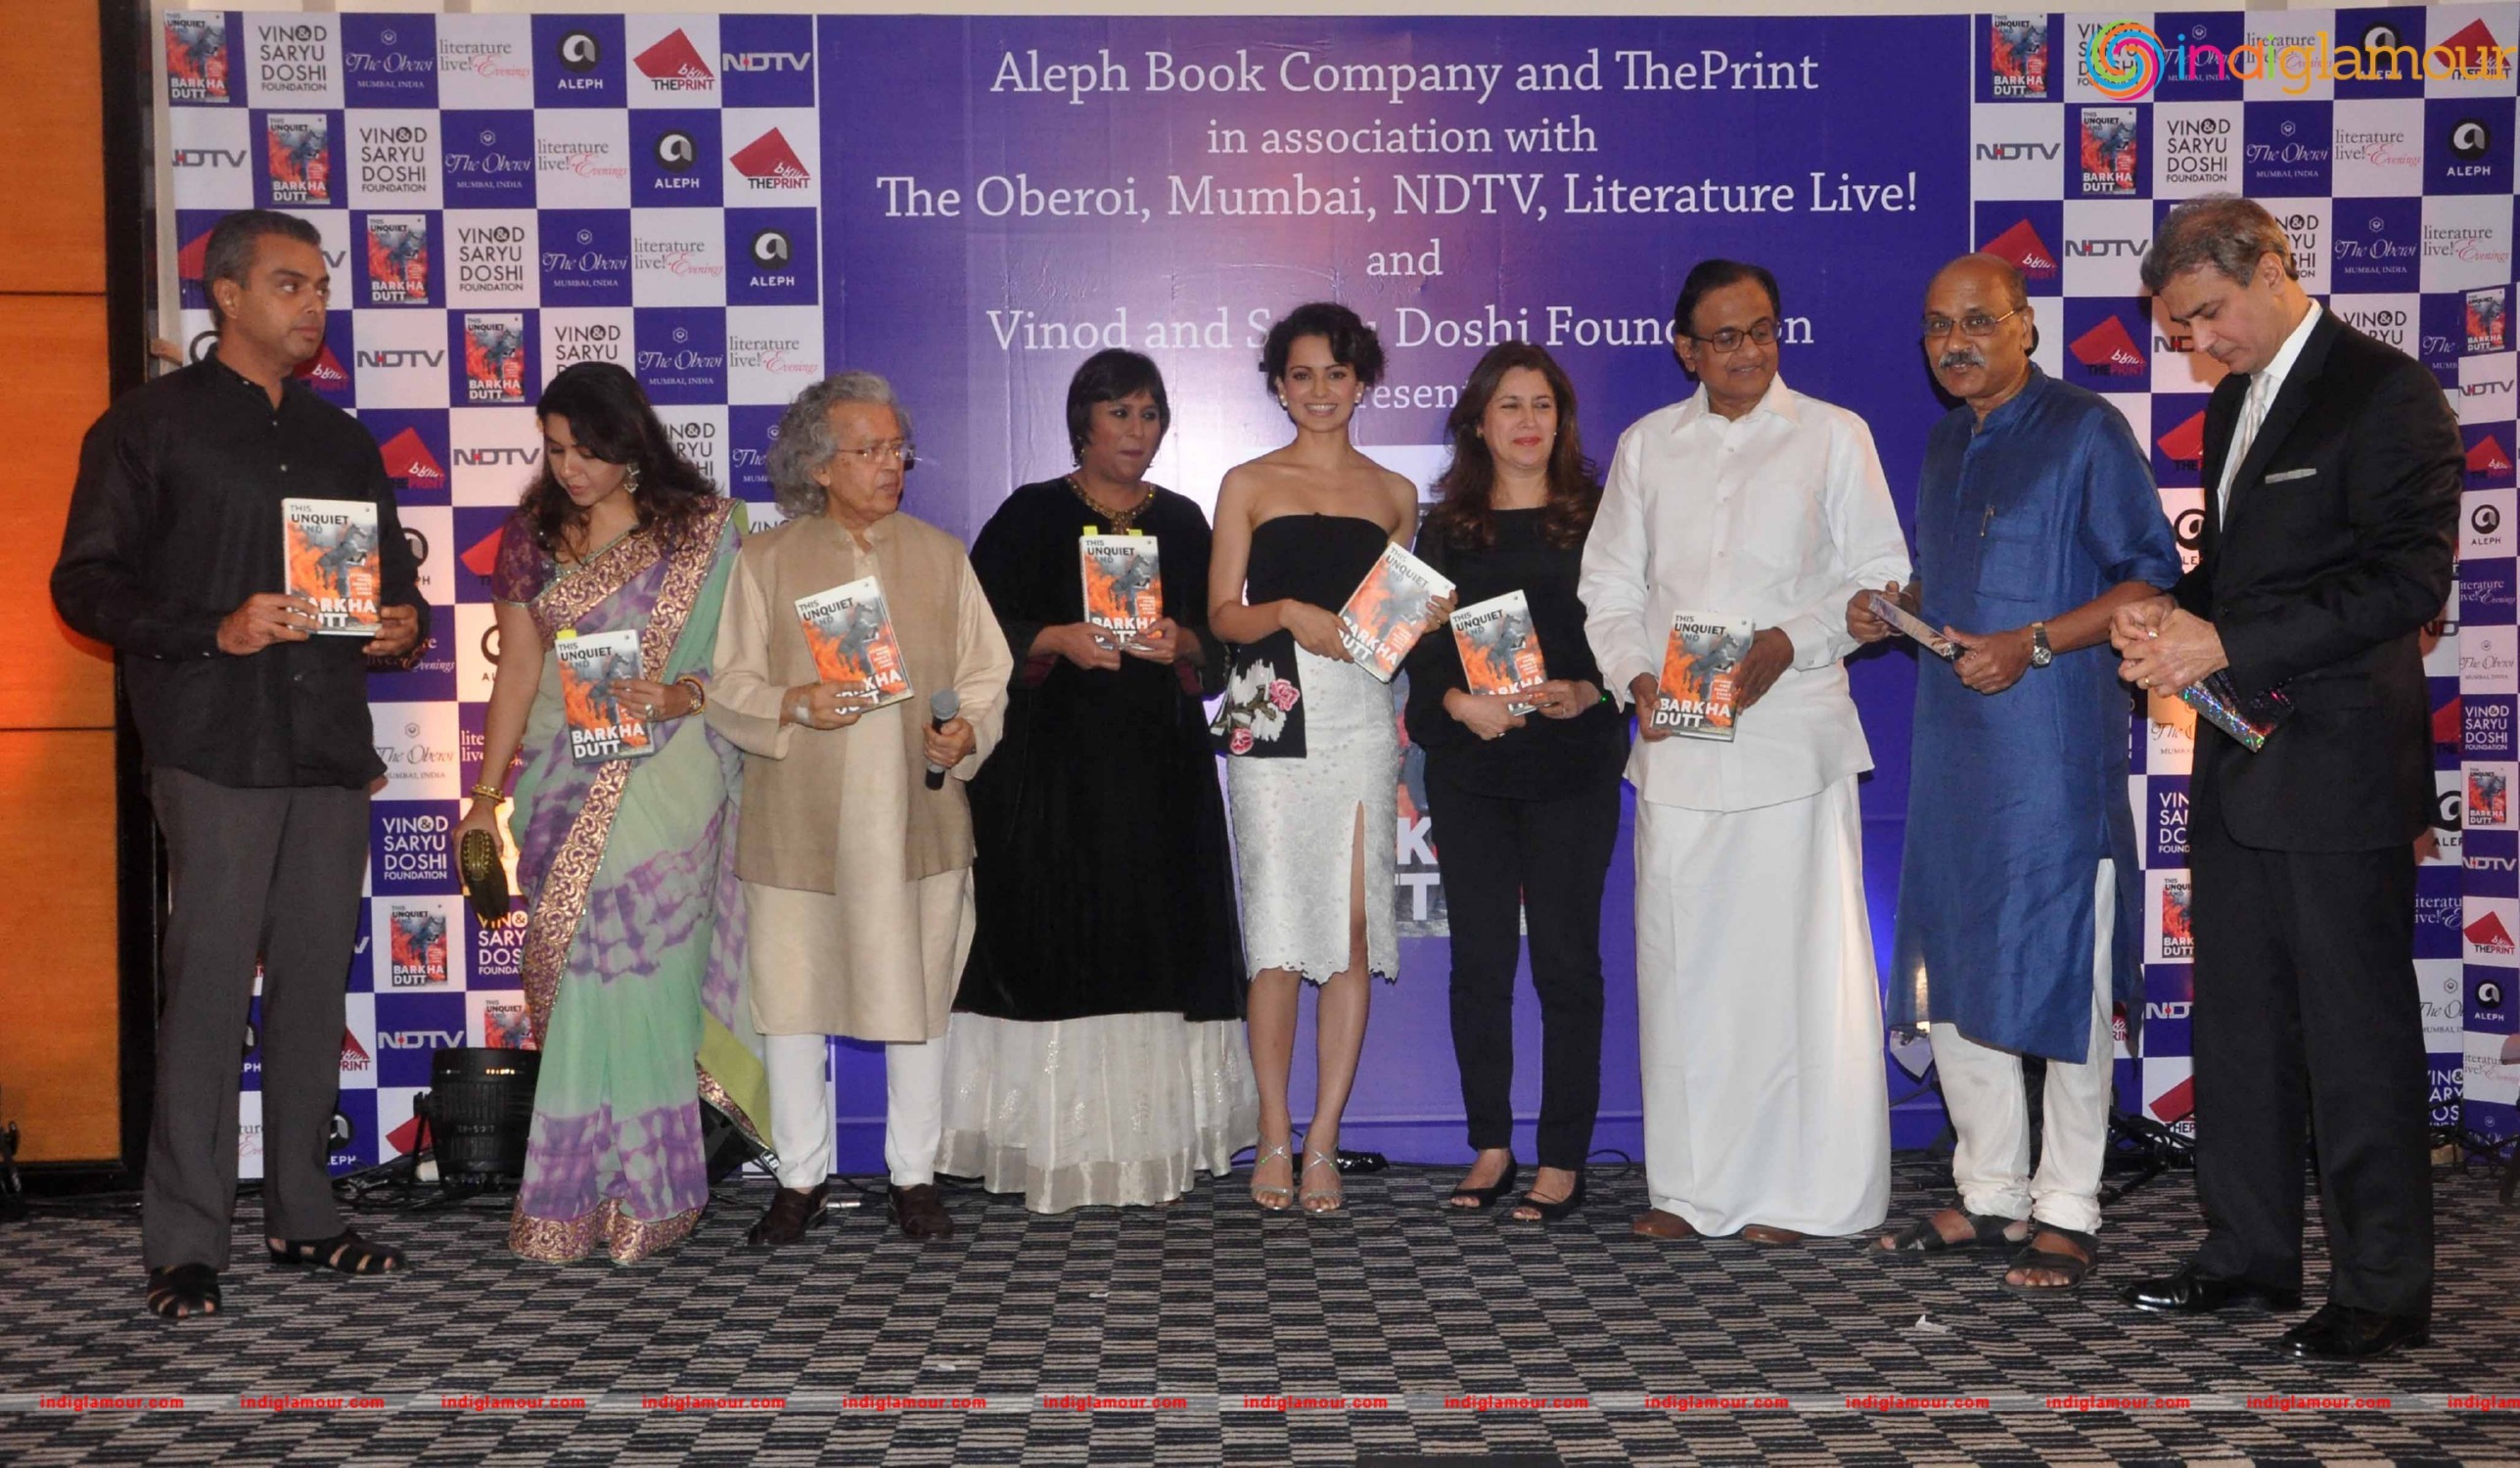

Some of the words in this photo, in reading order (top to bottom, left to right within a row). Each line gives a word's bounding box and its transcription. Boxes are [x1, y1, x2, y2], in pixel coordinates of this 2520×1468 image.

[260, 45, 325, 61] SARYU
[439, 39, 512, 55] literature
[345, 53, 381, 72] The
[384, 51, 435, 72] Oberoi
[722, 53, 811, 71] NDTV
[261, 65, 327, 82] DOSHI
[990, 49, 1129, 105] Aleph
[1145, 51, 1265, 92] Book
[1280, 52, 1503, 104] Company
[1516, 48, 1602, 91] and
[1616, 49, 1818, 90] ThePrint
[1994, 75, 2043, 85] BARKHA
[171, 78, 225, 89] BARKHA
[261, 82, 327, 92] FOUNDATION
[558, 78, 603, 90] ALEPH
[652, 78, 714, 90] THEPRINT
[1994, 86, 2026, 95] DUTT
[172, 88, 206, 98] DUTT
[270, 123, 308, 132] UNQUIET
[1208, 119, 1248, 155] in
[1261, 117, 1491, 154] association
[1505, 115, 1598, 153] with
[2335, 129, 2404, 143] literature
[538, 139, 609, 154] literature
[1976, 143, 2061, 161] NDTV
[2168, 138, 2226, 153] SARYU
[2247, 143, 2278, 162] The
[2281, 143, 2329, 162] Oberoi
[362, 148, 425, 162] SARYU
[444, 154, 479, 172] The
[481, 152, 530, 172] Oberoi
[2169, 158, 2227, 172] DOSHI
[2447, 166, 2491, 176] ALEPH
[362, 166, 426, 183] DOSHI
[2083, 172, 2131, 182] BARKHA
[273, 181, 325, 191] BARKHA
[362, 184, 426, 193] FOUNDATION
[654, 178, 699, 188] ALEPH
[748, 177, 810, 190] THEPRINT
[2083, 182, 2115, 192] DUTT
[274, 191, 307, 202] DUTT
[877, 176, 960, 217] The
[977, 174, 1151, 222] Oberoi,
[1168, 173, 1377, 221] Mumbai,
[1394, 173, 1546, 221] NDTV,
[1564, 172, 1795, 213] Literature
[1810, 172, 1917, 212] Live!
[2424, 225, 2493, 239] literature
[634, 239, 705, 252] literature
[2065, 240, 2149, 256] NDTV
[2335, 240, 2367, 260] The
[2370, 239, 2418, 258] Oberoi
[459, 247, 522, 262] SARYU
[542, 252, 575, 272] The
[579, 252, 628, 272] Oberoi
[1366, 239, 1443, 276] and
[460, 266, 523, 282] DOSHI
[750, 276, 795, 286] ALEPH
[372, 291, 406, 301] DUTT
[986, 306, 1127, 350] Vinod
[1144, 306, 1229, 350] and
[1396, 304, 1531, 347] Doshi
[729, 337, 799, 350] literature
[2468, 335, 2502, 344] BARKHA
[357, 350, 444, 368] NDTV
[556, 344, 618, 360] SARYU
[638, 350, 671, 370] The
[674, 350, 724, 370] Oberoi
[470, 380, 521, 390] BARKHA
[2458, 380, 2513, 397] NDTV
[470, 390, 503, 399] DUTT
[453, 448, 540, 466] NDTV
[733, 448, 765, 468] The
[292, 514, 348, 525] UNQUIET
[1390, 547, 1407, 562] THIS
[1386, 555, 1429, 587] UNQUIET
[799, 600, 819, 611] THIS
[802, 597, 853, 620] UNQUIET
[1453, 612, 1472, 622] THIS
[1456, 610, 1503, 631] UNQUIET
[1674, 623, 1726, 635] UNQUIET
[558, 642, 577, 651] THIS
[1343, 617, 1398, 665] BARKHA
[560, 647, 612, 662] UNQUIET
[1660, 699, 1730, 717] BARKHA
[1656, 712, 1703, 727] DUTT
[2466, 718, 2507, 730] SARYU
[572, 724, 645, 744] BARKHA
[2466, 732, 2507, 744] DOSHI
[407, 745, 454, 763] Oberoi
[574, 741, 620, 757] DUTT
[384, 836, 445, 851] SARYU
[385, 853, 446, 869] DOSHI
[2462, 857, 2517, 871] NDTV
[385, 871, 447, 880] FOUNDATION
[2474, 945, 2515, 955] THEPRINT
[393, 965, 444, 975] BARKHA
[393, 975, 427, 985] DUTT
[2475, 1013, 2504, 1022] ALEPH
[378, 1032, 464, 1049] NDTV
